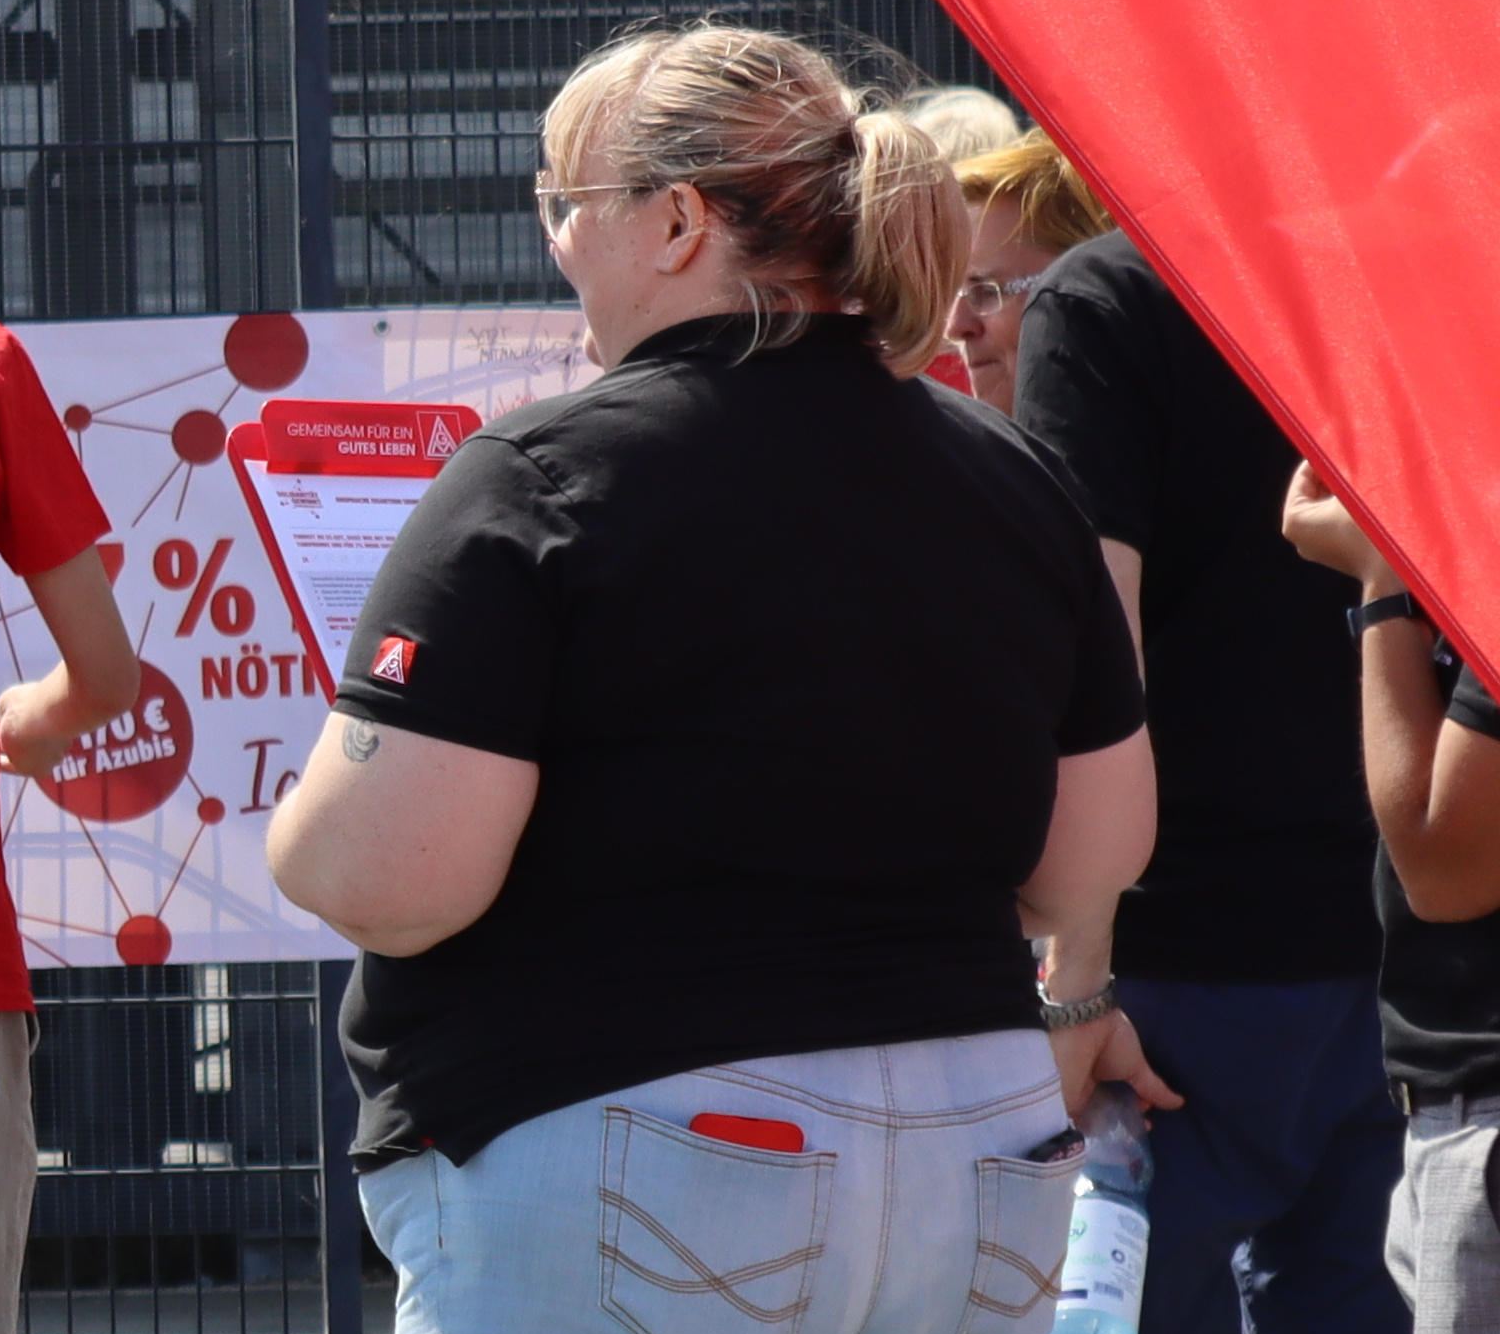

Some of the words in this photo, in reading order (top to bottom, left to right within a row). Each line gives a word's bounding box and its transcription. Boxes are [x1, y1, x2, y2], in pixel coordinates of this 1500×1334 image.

[287, 422, 365, 438] GEMEINSAM
[367, 424, 391, 439] FÜR
[393, 426, 413, 440] EIN
[338, 441, 376, 455] GUTES
[379, 442, 416, 456] LEBEN
[201, 643, 316, 700] NÖTI
[143, 697, 171, 732] €
[95, 735, 177, 773] Azubis
